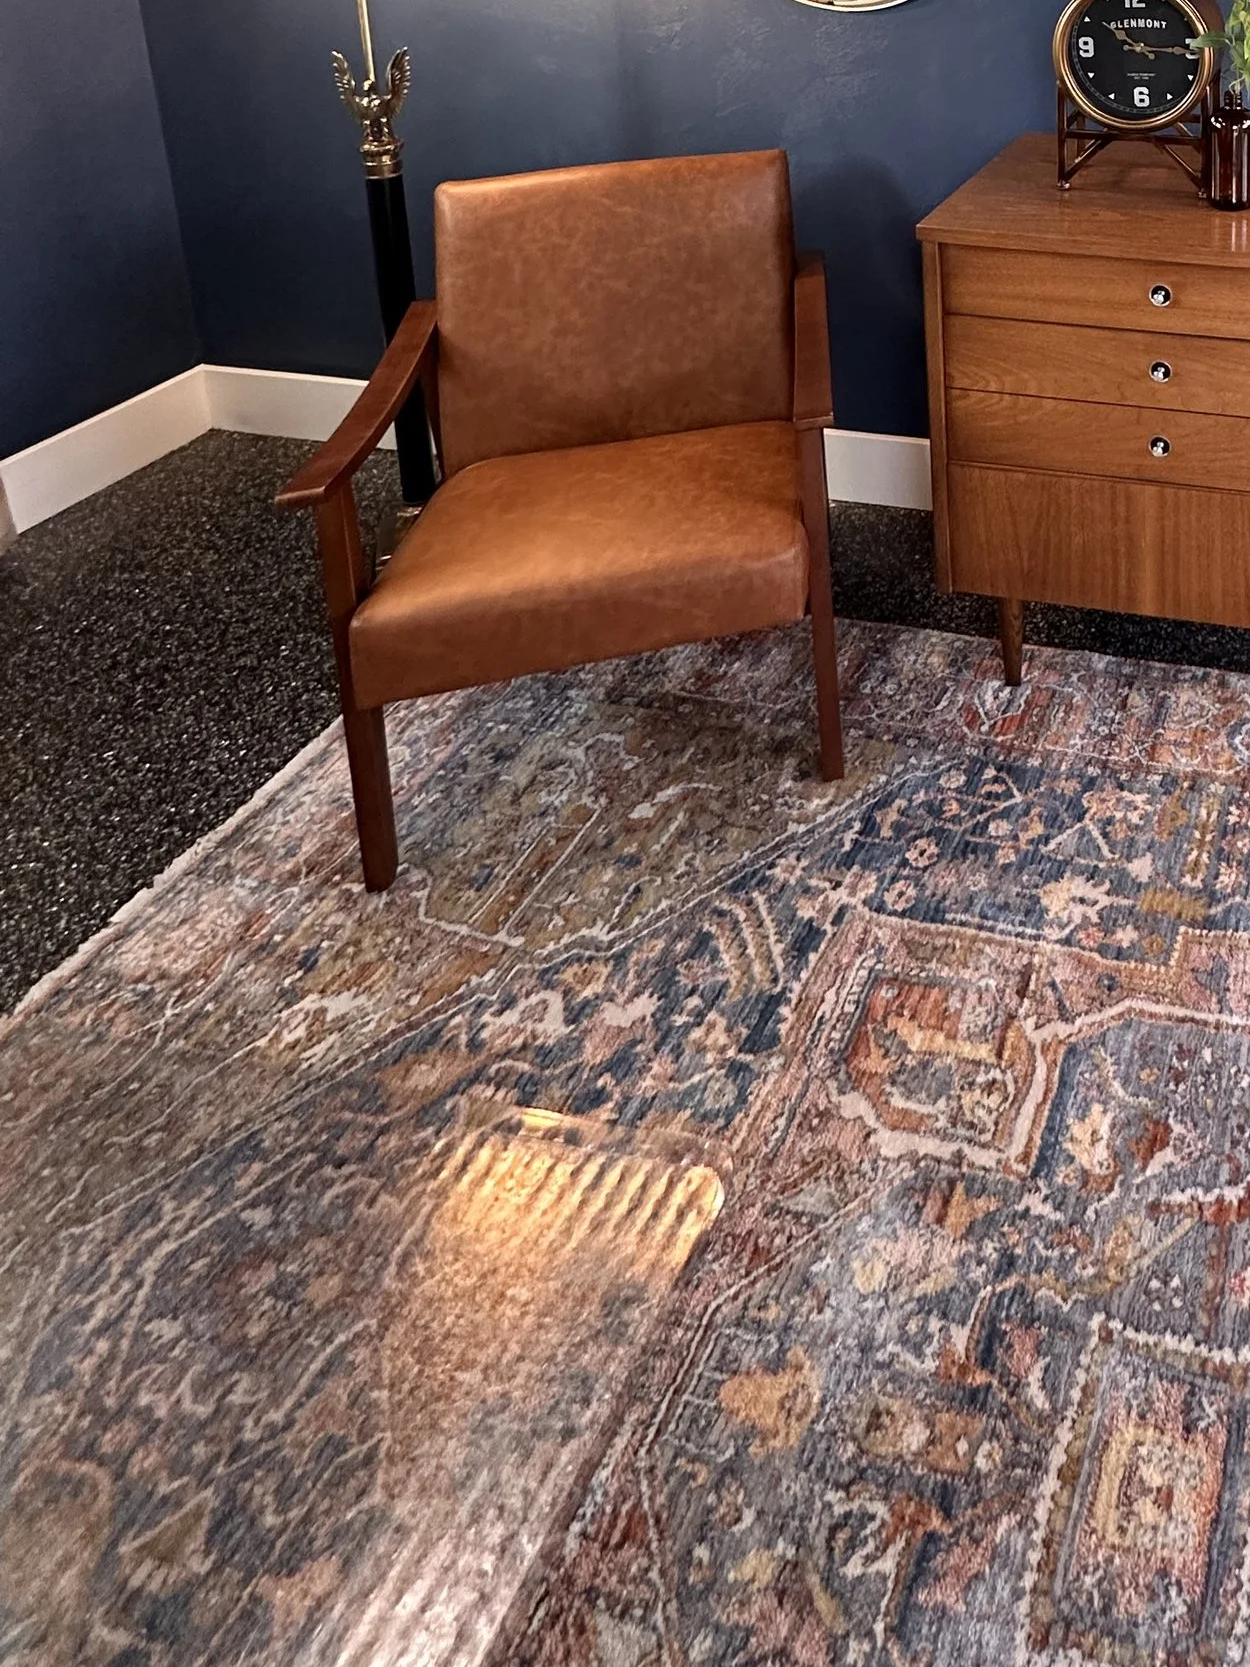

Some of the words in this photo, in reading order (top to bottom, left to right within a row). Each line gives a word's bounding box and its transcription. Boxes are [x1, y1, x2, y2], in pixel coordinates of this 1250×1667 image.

[1110, 18, 1167, 29] GLENMONT
[1078, 36, 1095, 58] 9
[1133, 86, 1150, 107] 6
